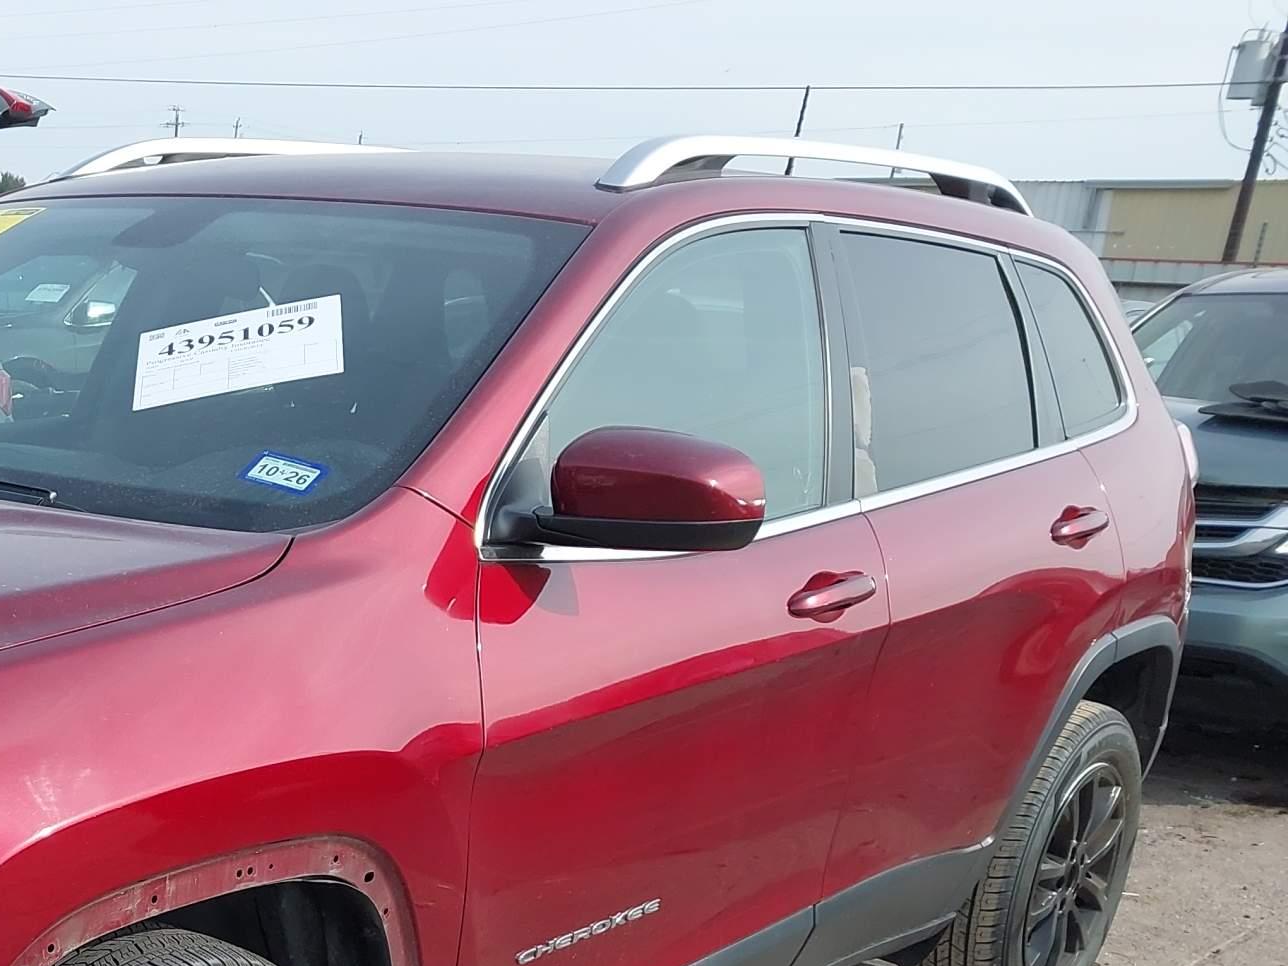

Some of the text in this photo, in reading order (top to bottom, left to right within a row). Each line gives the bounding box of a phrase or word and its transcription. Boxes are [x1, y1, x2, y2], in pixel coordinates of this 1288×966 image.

[158, 316, 315, 356] 43951059
[257, 463, 310, 485] 10 26
[515, 898, 661, 965] CHEROKEE
